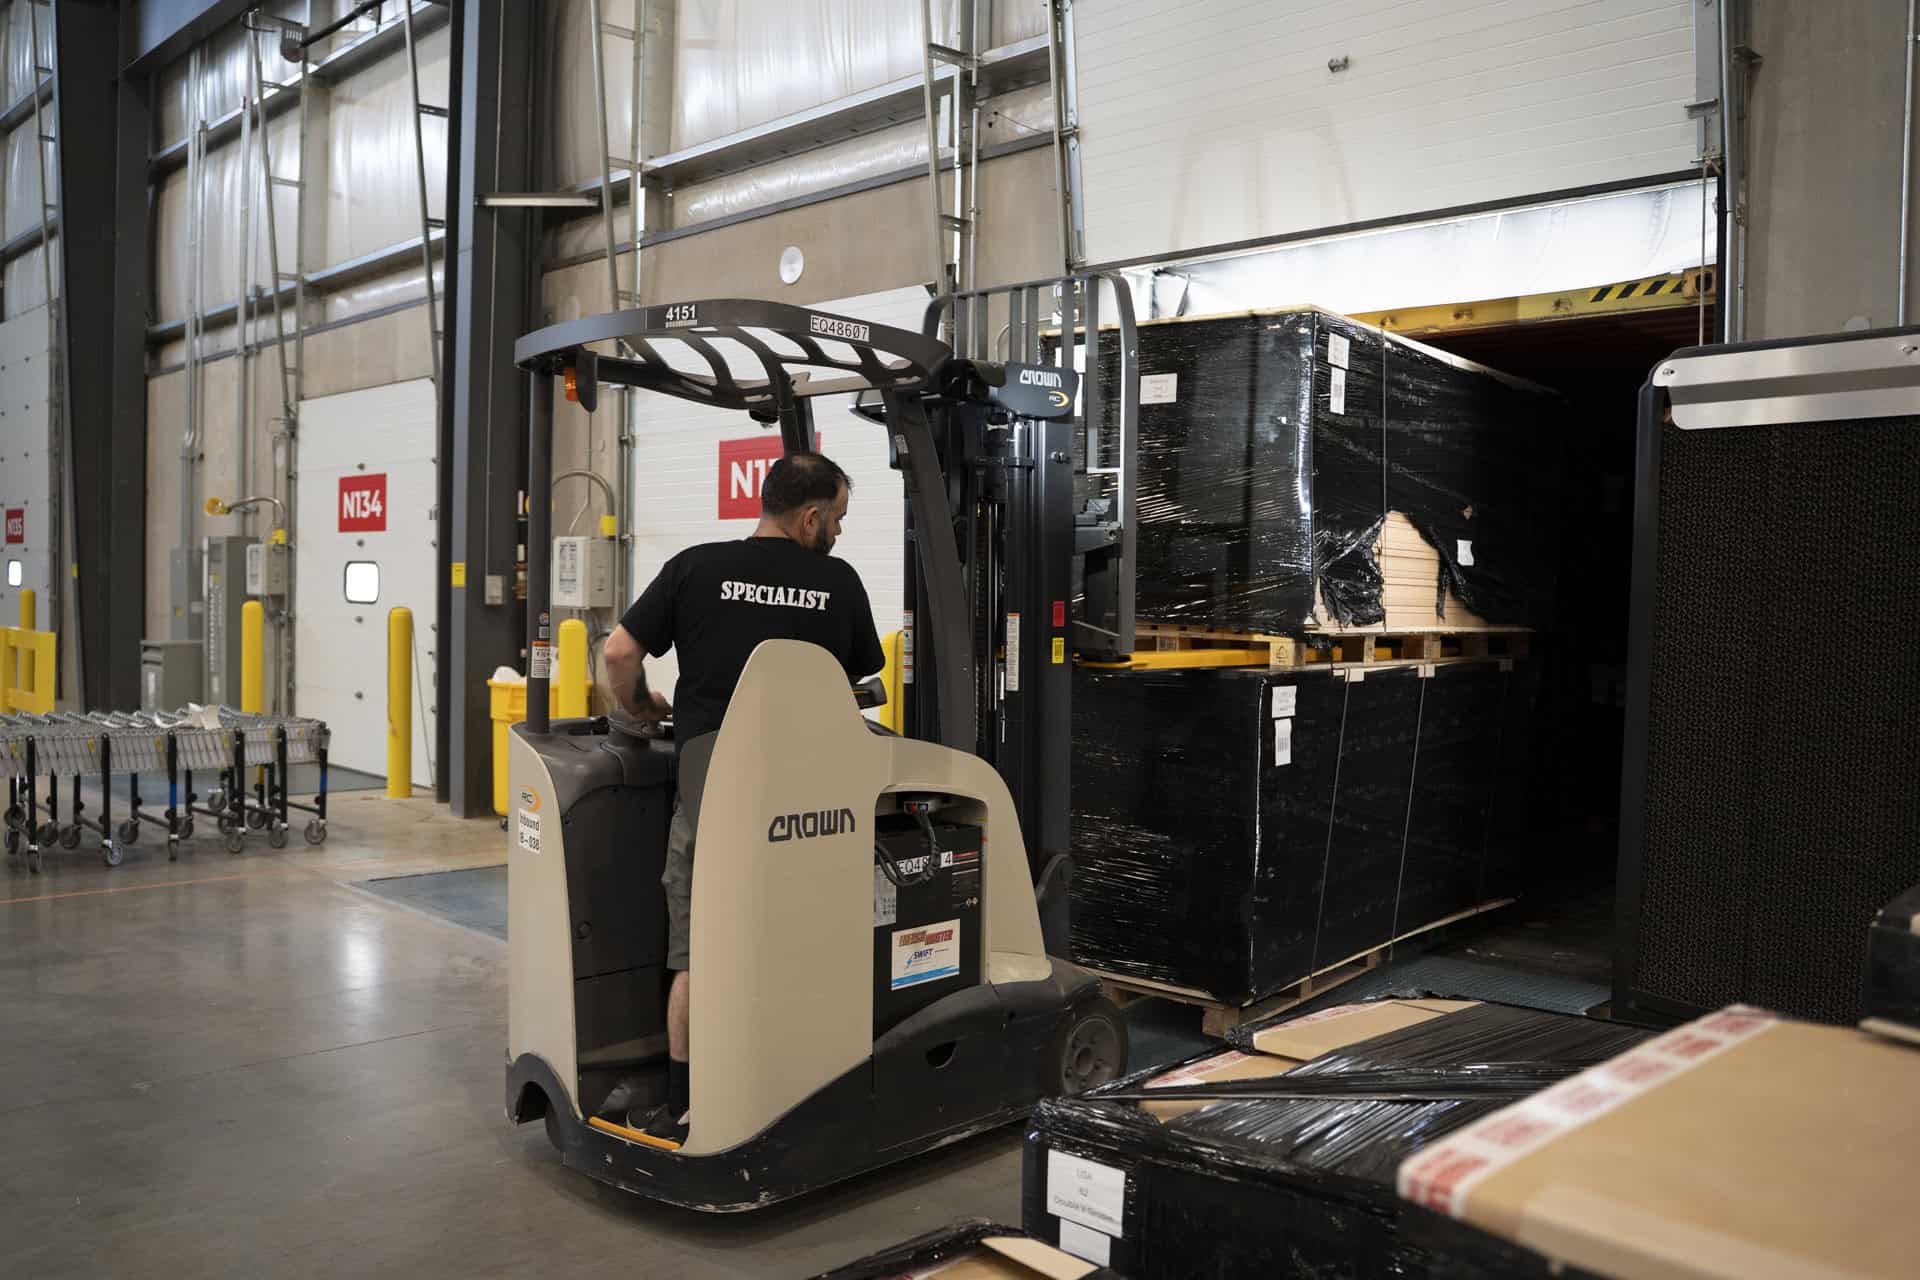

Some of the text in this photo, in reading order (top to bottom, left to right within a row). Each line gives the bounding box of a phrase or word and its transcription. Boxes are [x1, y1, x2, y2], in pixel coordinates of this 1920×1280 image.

[665, 304, 697, 321] 4151
[811, 316, 868, 339] EQ48607
[1019, 369, 1062, 388] CROWN
[343, 489, 383, 519] N134
[720, 580, 830, 610] SPECIALIST
[768, 807, 856, 842] CROWN
[913, 948, 934, 960] SWIFT
